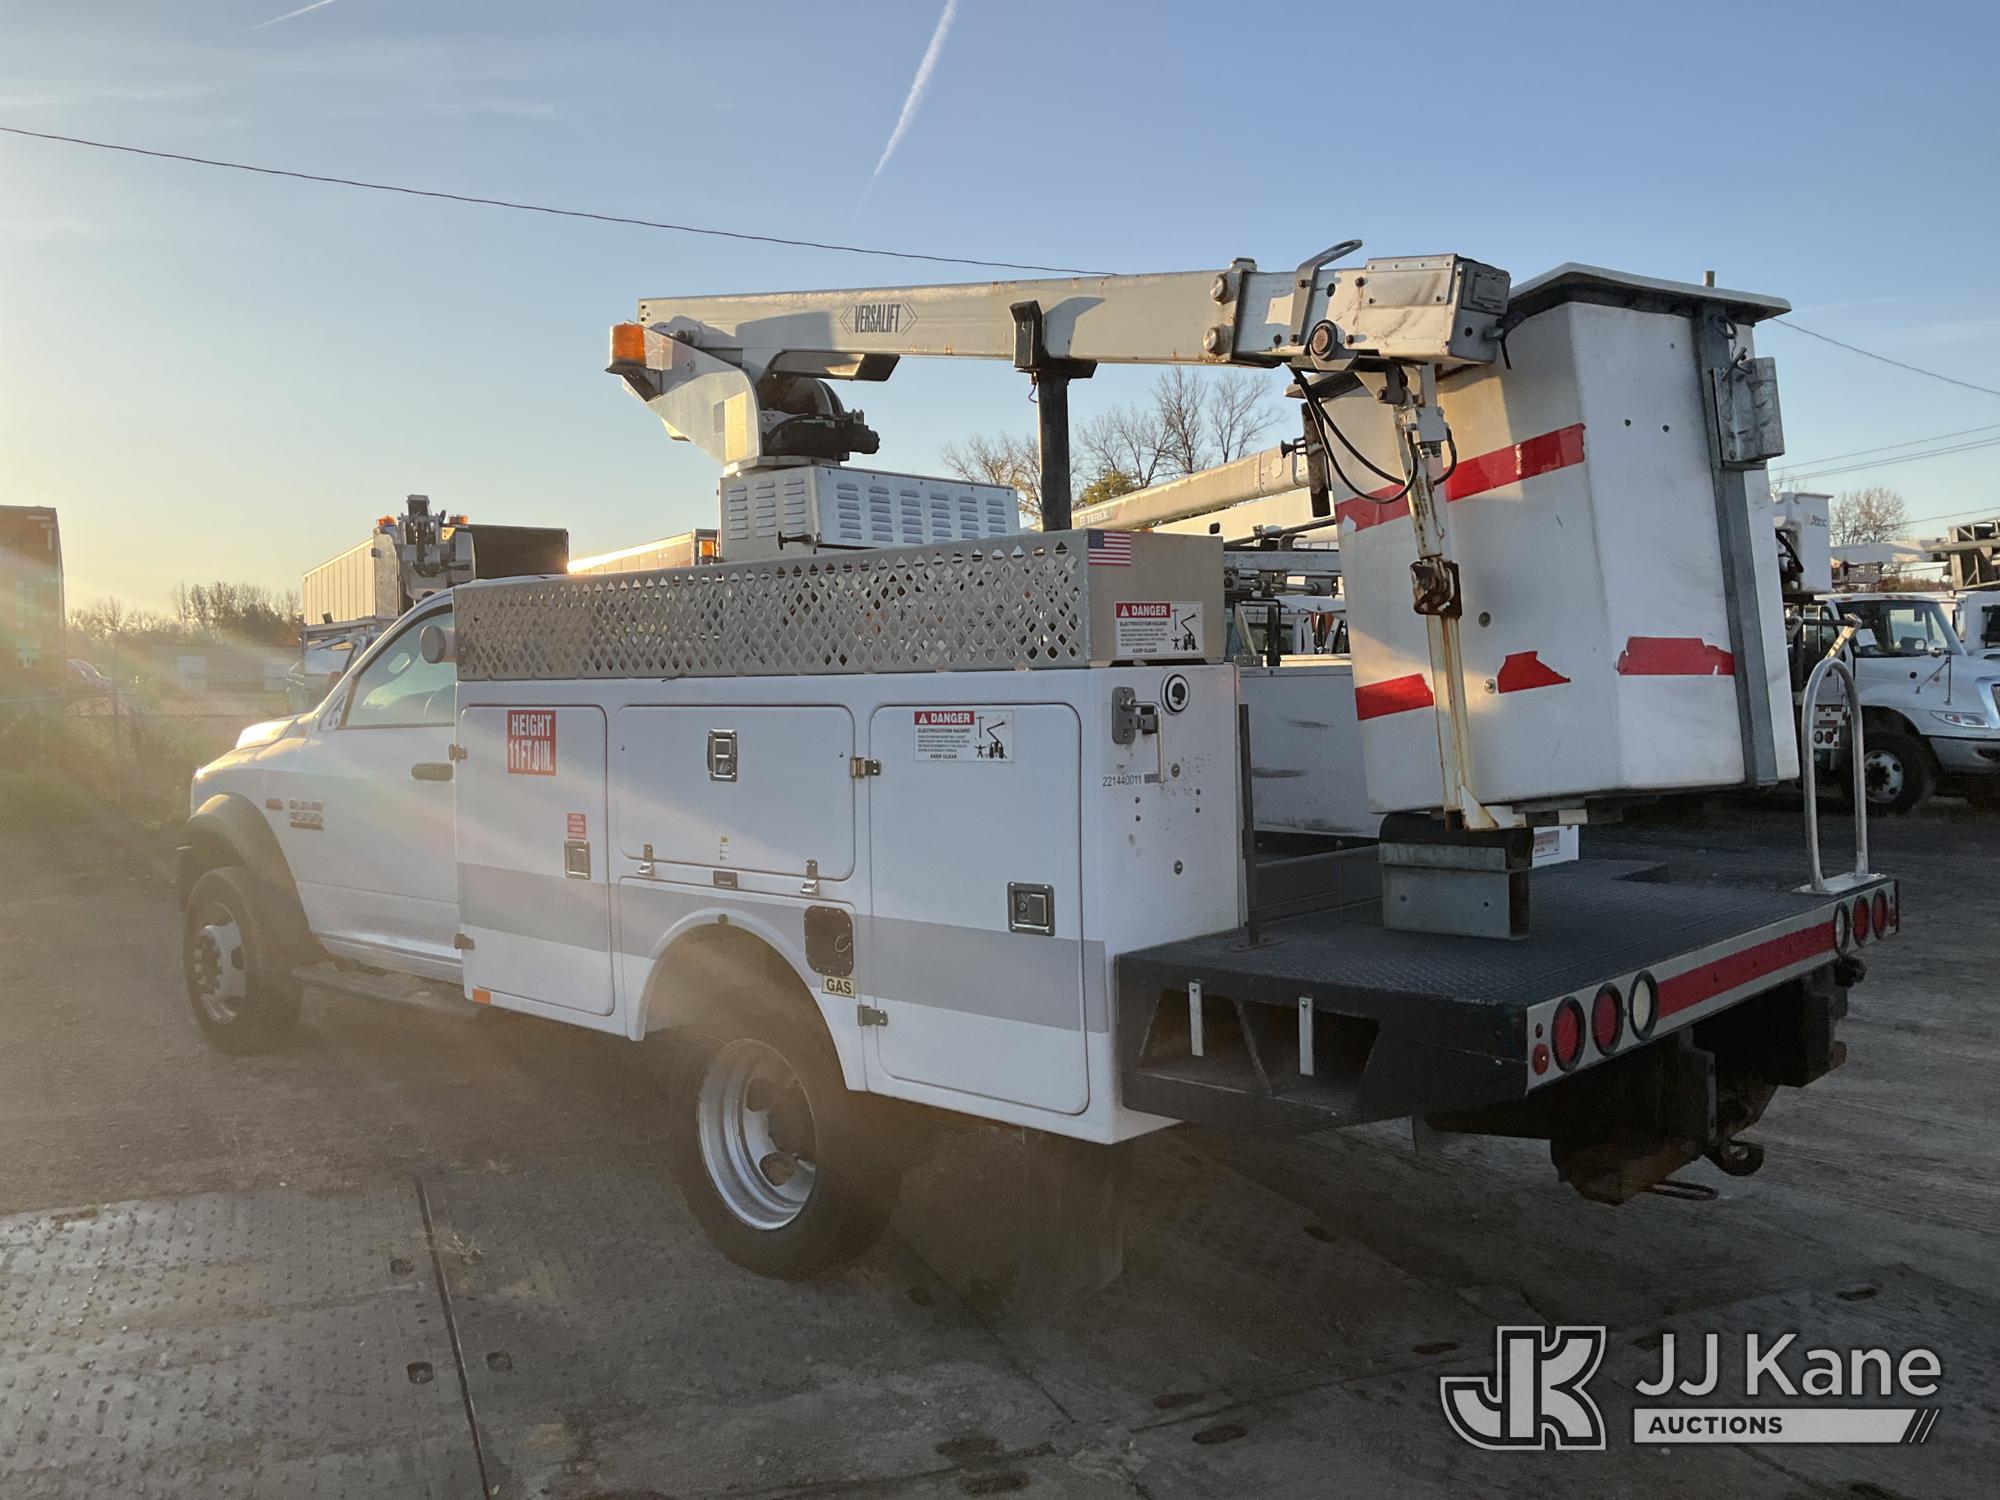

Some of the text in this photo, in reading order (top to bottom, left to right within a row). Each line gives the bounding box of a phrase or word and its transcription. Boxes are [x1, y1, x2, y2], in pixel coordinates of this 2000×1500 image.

[854, 303, 901, 334] VERSALIFT
[1131, 604, 1167, 617] DANGER
[511, 713, 552, 737] HEIGHT
[930, 712, 971, 724] DANGER
[1102, 774, 1142, 787] 221440011
[826, 978, 852, 995] GAS
